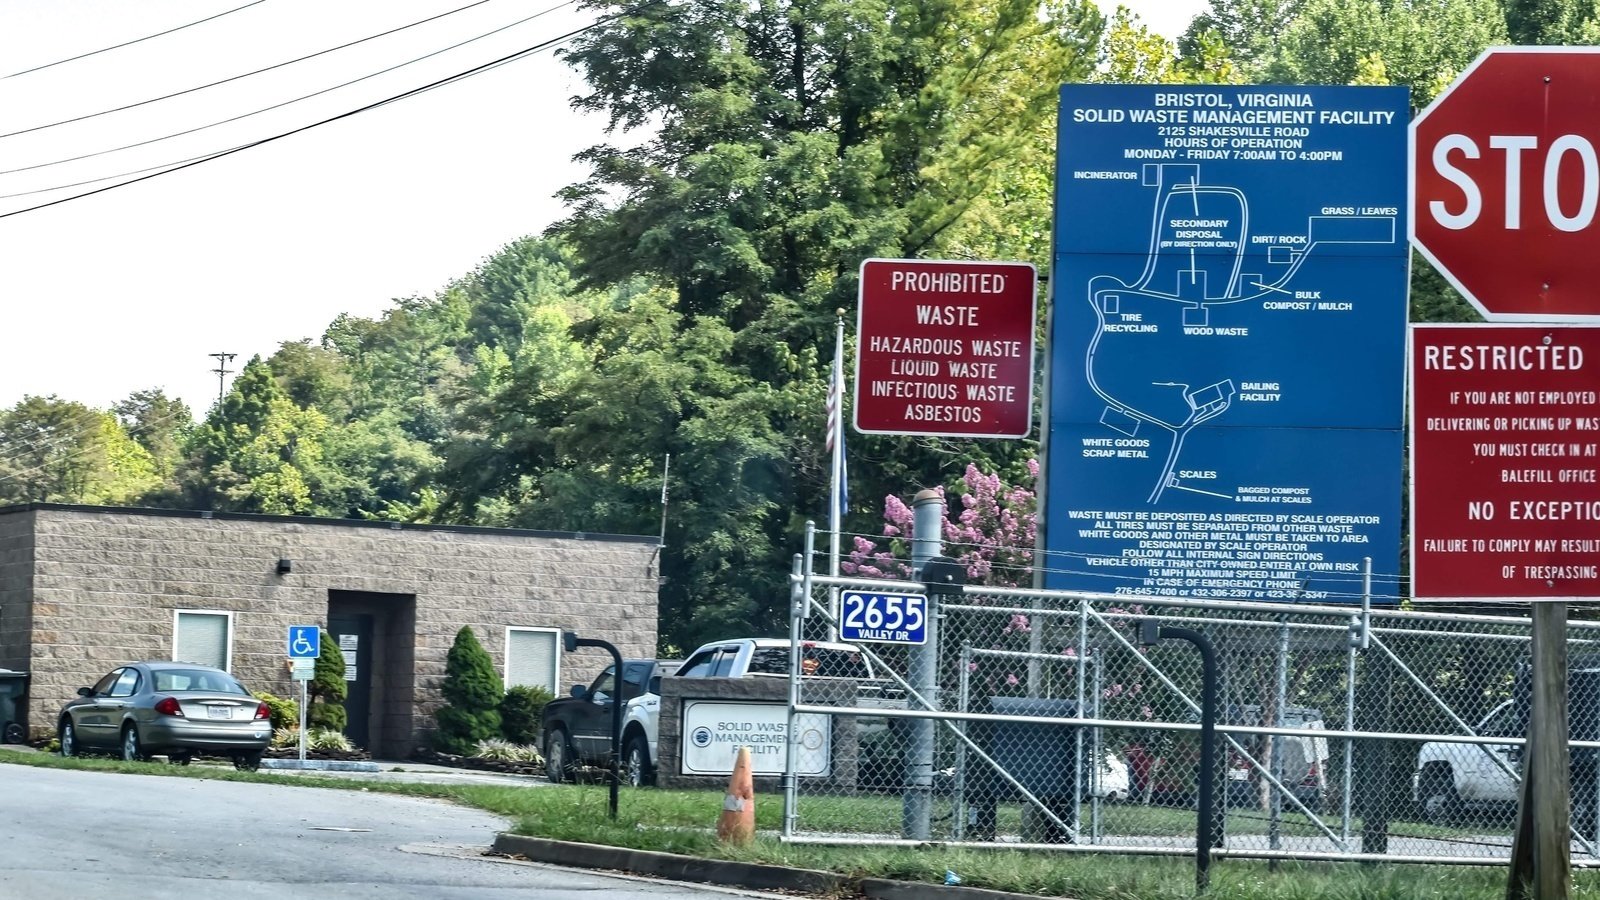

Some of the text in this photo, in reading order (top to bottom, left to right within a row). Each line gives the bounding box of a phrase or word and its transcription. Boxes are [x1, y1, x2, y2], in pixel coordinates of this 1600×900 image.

[1155, 94, 1313, 109] BRISTOL, VIRGINIA
[1073, 109, 1394, 124] SOLID WASTE MANAGEMENT FACILITY
[1158, 127, 1309, 137] 2125 SHAKESVILLE ROAD
[1164, 138, 1302, 148] HOURS OF OPERATION
[1124, 150, 1176, 159] MONDAY
[1187, 150, 1230, 160] FRIDAY
[1233, 150, 1276, 160] 7:00AM
[1278, 150, 1296, 160] TO
[1299, 151, 1342, 160] 4:00PM
[1074, 171, 1137, 180] INCINERATOR
[1429, 134, 1600, 232] STO
[1321, 207, 1354, 215] GRASS
[1362, 207, 1397, 215] LEAVES
[1170, 220, 1228, 228] SECONDARY
[1175, 231, 1222, 239] DISPOSAL
[1278, 236, 1307, 244] ROCK
[892, 271, 1004, 293] PROHIBITED
[1295, 291, 1320, 299] BULK
[1263, 302, 1311, 310] COMPOST
[1318, 303, 1352, 311] MULCH
[916, 305, 978, 326] WASTE
[1120, 314, 1141, 322] TIRE
[1104, 324, 1157, 333] RECYCLING
[1183, 328, 1248, 336] WOOD WASTE
[870, 336, 1020, 357] HAZARDOUS WASTE
[1425, 346, 1583, 370] RESTRICTED
[891, 360, 997, 378] LIQUID WASTE
[872, 381, 1015, 401] INFECTIOUS WASTE
[1241, 382, 1279, 391] BAILING
[1239, 393, 1280, 401] FACILITY
[1451, 392, 1595, 404] IF YOU ARE NOT EMPLOYED
[904, 404, 981, 422] ASBESTOS
[1427, 418, 1600, 430] DELIVERING OR PICKING UP WAS
[1082, 439, 1149, 447] WHITE GOODS
[1082, 449, 1148, 458] SCRAP METAL
[1473, 444, 1596, 456] YOU MUST CHECK IN AT
[1179, 471, 1216, 479] SCALES
[1501, 470, 1595, 482] BALEFILL OFFICE
[1468, 501, 1494, 520] NO
[1068, 511, 1379, 524] WASTE MUST BE DEPOSITED AS DIRECTED BY SCALE OPERATOR
[1094, 521, 1352, 533] ALL TIRES MUST BE SEPARATED FROM OTHER WASTE
[1078, 530, 1368, 543] WHITE GOODS AND OTHER METAL MUST BE TAKEN TO AREA
[1139, 541, 1307, 551] DESIGNATED BY SCALE OPERATOR
[1424, 539, 1600, 552] FAILURE TO COMPLY MAY RESULT
[1122, 550, 1323, 561] FOLLOW ALL INTERNAL SIGN DIRECTIONS
[1086, 558, 1358, 571] VEHICLE OTHER THAN CITY OWNED ENTER AT OWN RISK
[1148, 569, 1297, 579] 15 MPH MAXIMUM SPEED LIMIT
[1502, 566, 1597, 578] OF TRESPASSING
[1156, 579, 1183, 587] CASE
[1186, 579, 1200, 587] OF
[1202, 579, 1263, 588] EMERGENCY
[1265, 580, 1300, 588] PHONE
[1115, 587, 1177, 596] 276-645-7400
[1178, 588, 1189, 596] or
[1191, 588, 1252, 598] 432-306-2397
[1254, 589, 1265, 598] or
[845, 595, 923, 630] 2655
[858, 629, 894, 639] VALLEY
[718, 722, 752, 731] SOLID
[732, 745, 781, 754] FCILITY
